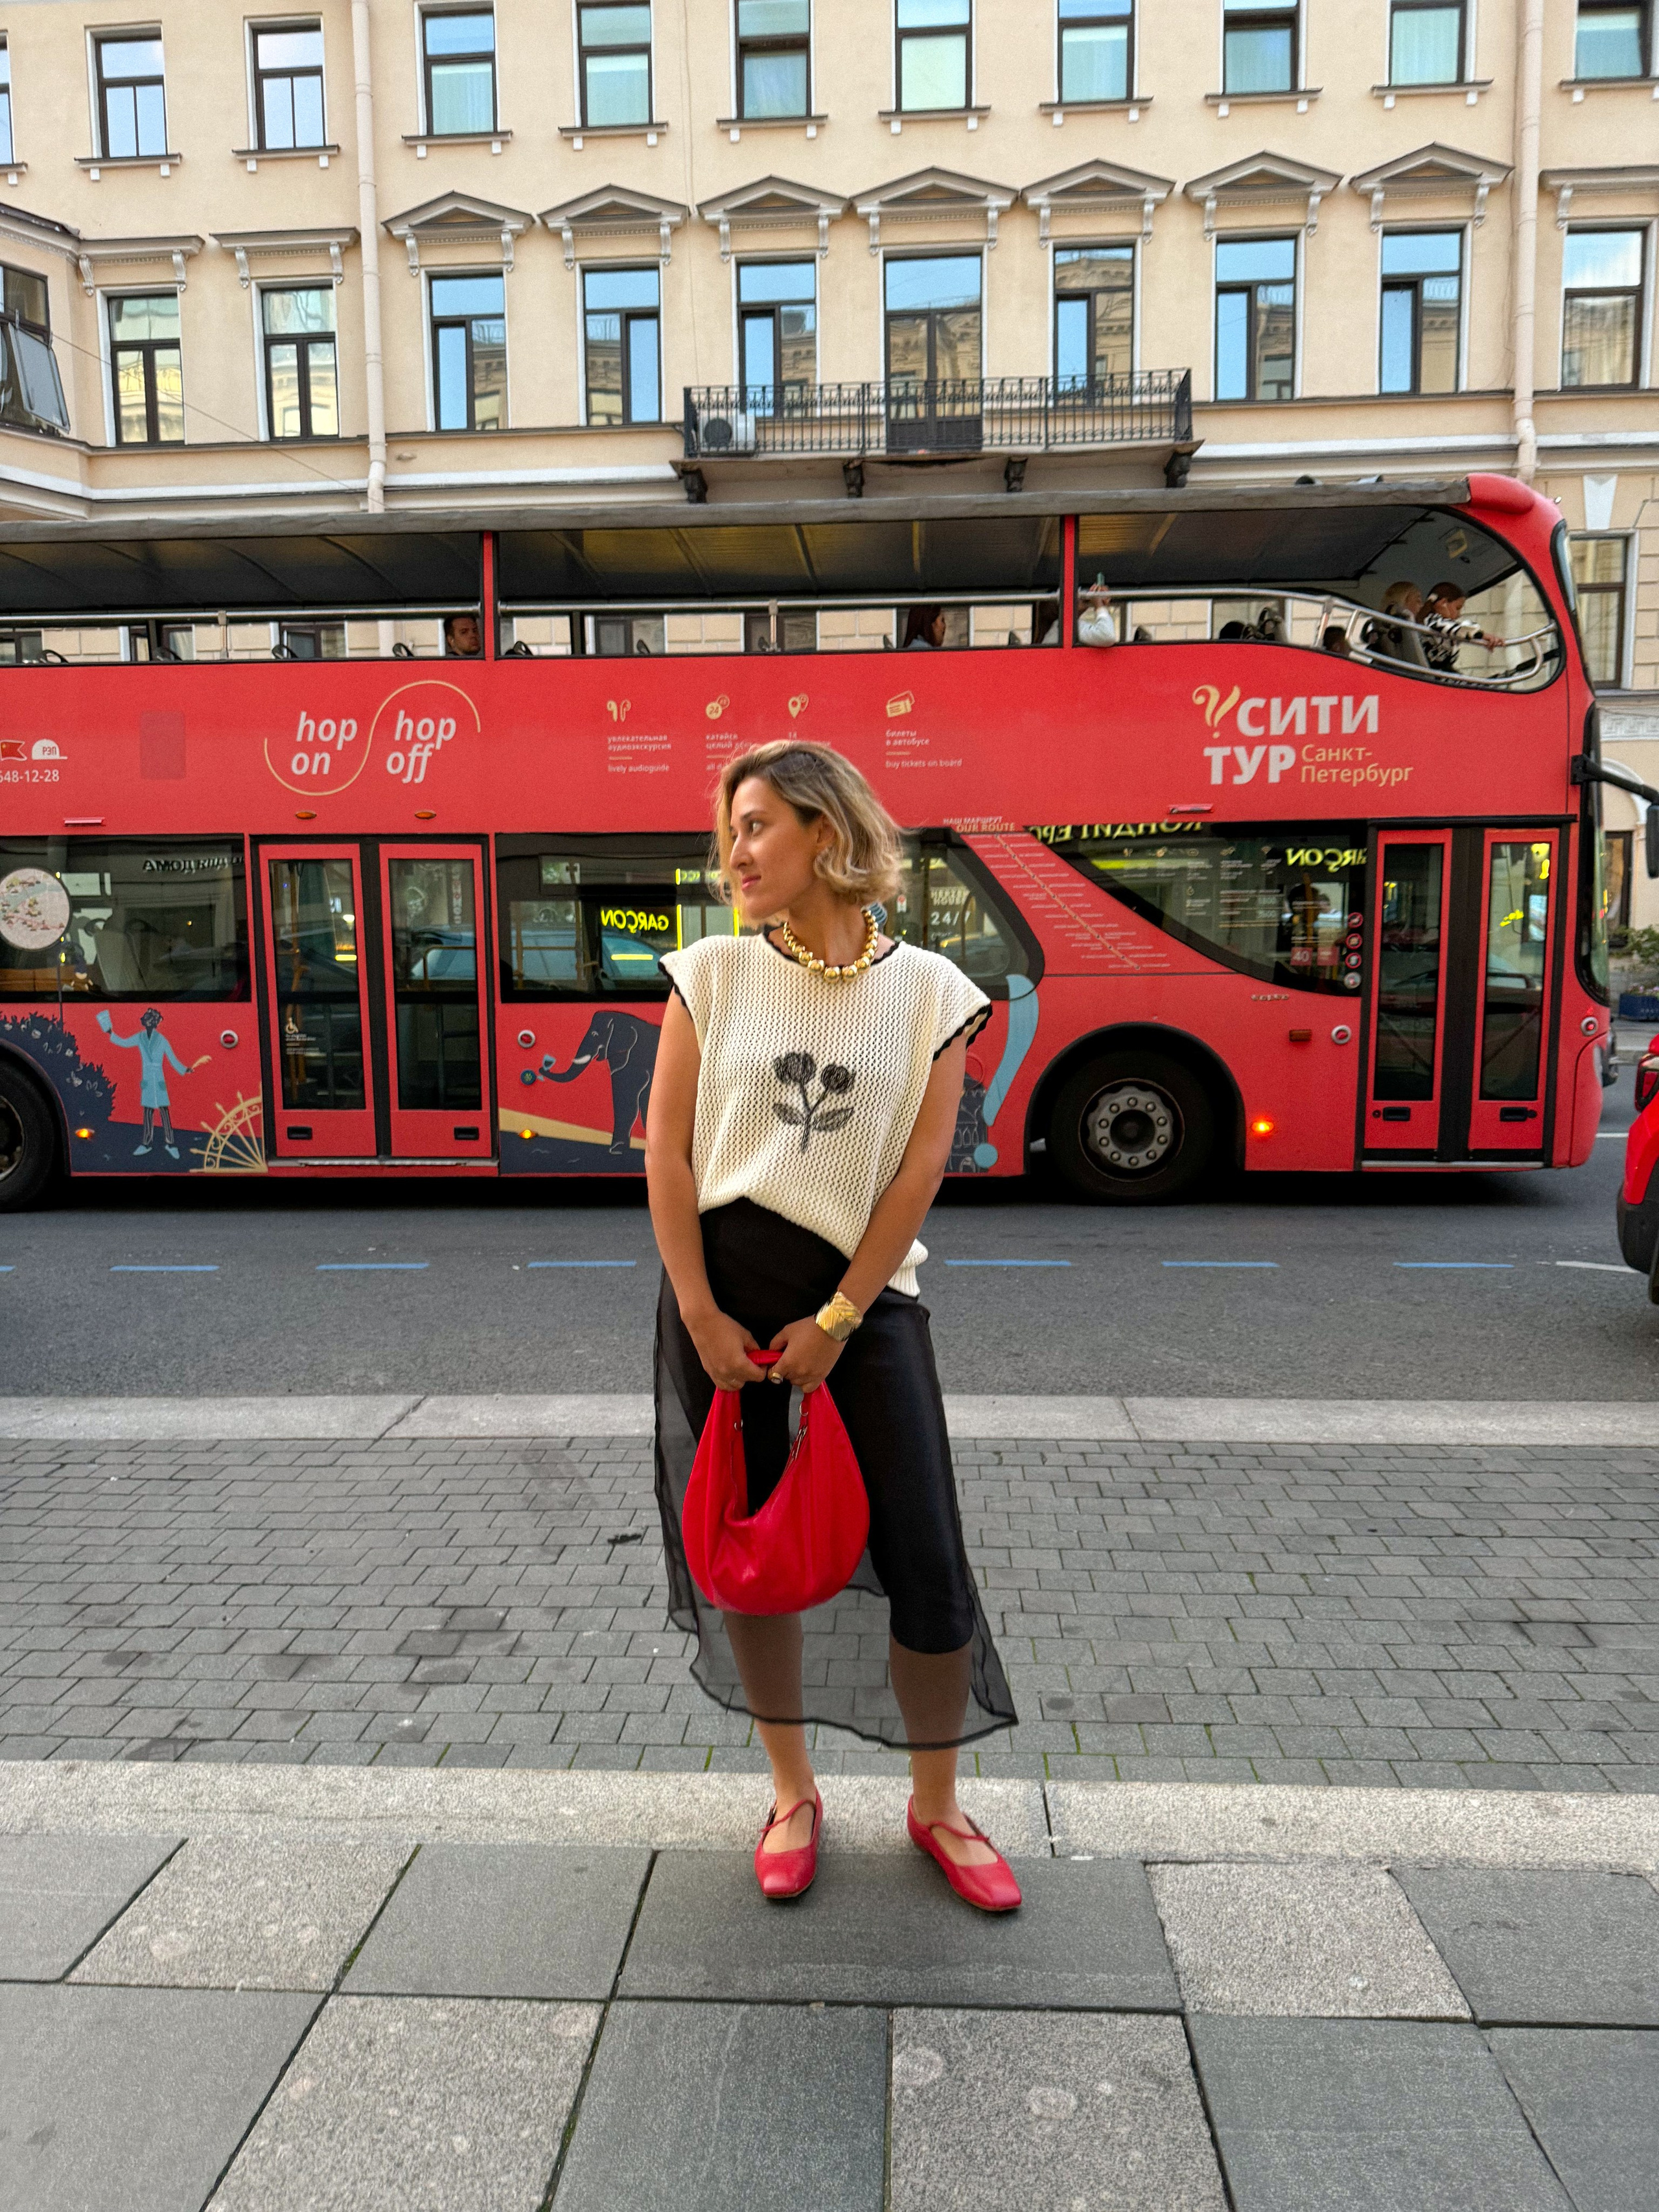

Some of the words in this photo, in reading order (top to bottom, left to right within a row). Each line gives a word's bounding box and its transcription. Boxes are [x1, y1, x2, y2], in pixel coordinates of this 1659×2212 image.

[1236, 695, 1378, 736] СИТИ
[296, 711, 358, 751] hop
[395, 710, 456, 750] hop
[608, 735, 667, 743] увлекательная
[893, 738, 930, 747] автобусе
[1302, 744, 1373, 762] Санкт-
[291, 752, 331, 775] on
[386, 743, 435, 784] off
[885, 760, 900, 769] buy
[939, 758, 962, 767] board
[1203, 746, 1296, 785] ТУР
[1301, 763, 1413, 787] Петербург
[956, 823, 979, 833] OUR
[981, 822, 1015, 832] ROUTE
